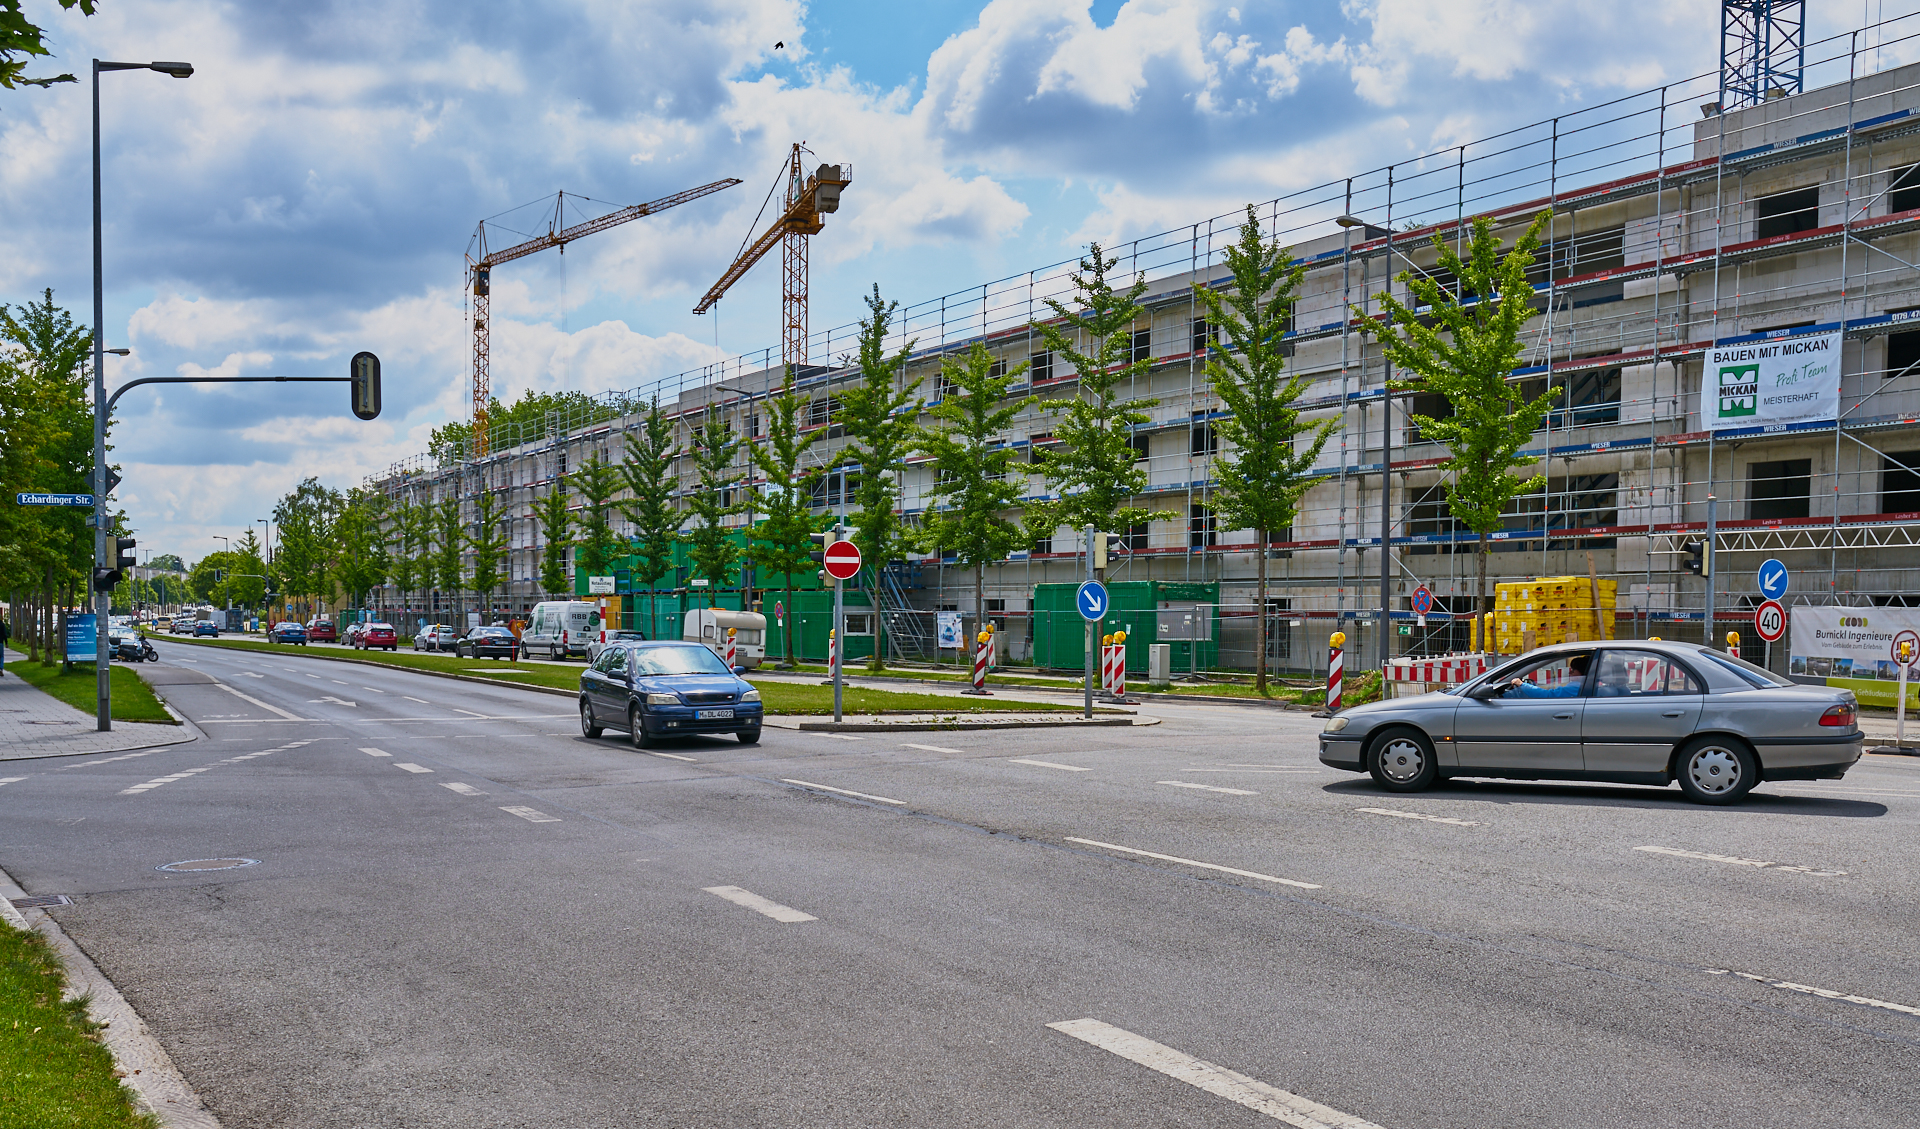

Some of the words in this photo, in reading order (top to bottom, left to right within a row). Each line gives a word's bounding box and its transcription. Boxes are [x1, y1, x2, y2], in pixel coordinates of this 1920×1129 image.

[1773, 137, 1797, 149] WIESER
[1766, 328, 1790, 338] WIESER
[1713, 349, 1756, 363] BAUEN
[1759, 346, 1779, 359] MIT
[1782, 339, 1829, 356] MICKAN
[1776, 368, 1798, 388] Profi
[1801, 361, 1828, 379] Team
[1719, 384, 1758, 397] MICKAN
[1763, 392, 1819, 406] MEISTERHAFT
[1763, 424, 1787, 433] WIESER
[1591, 441, 1610, 449] WIESER
[22, 494, 73, 505] Echardinger
[75, 495, 90, 504] Str.
[1762, 612, 1779, 630] 40
[1815, 629, 1847, 640] Burnickl
[1848, 631, 1893, 643] Ingenieure
